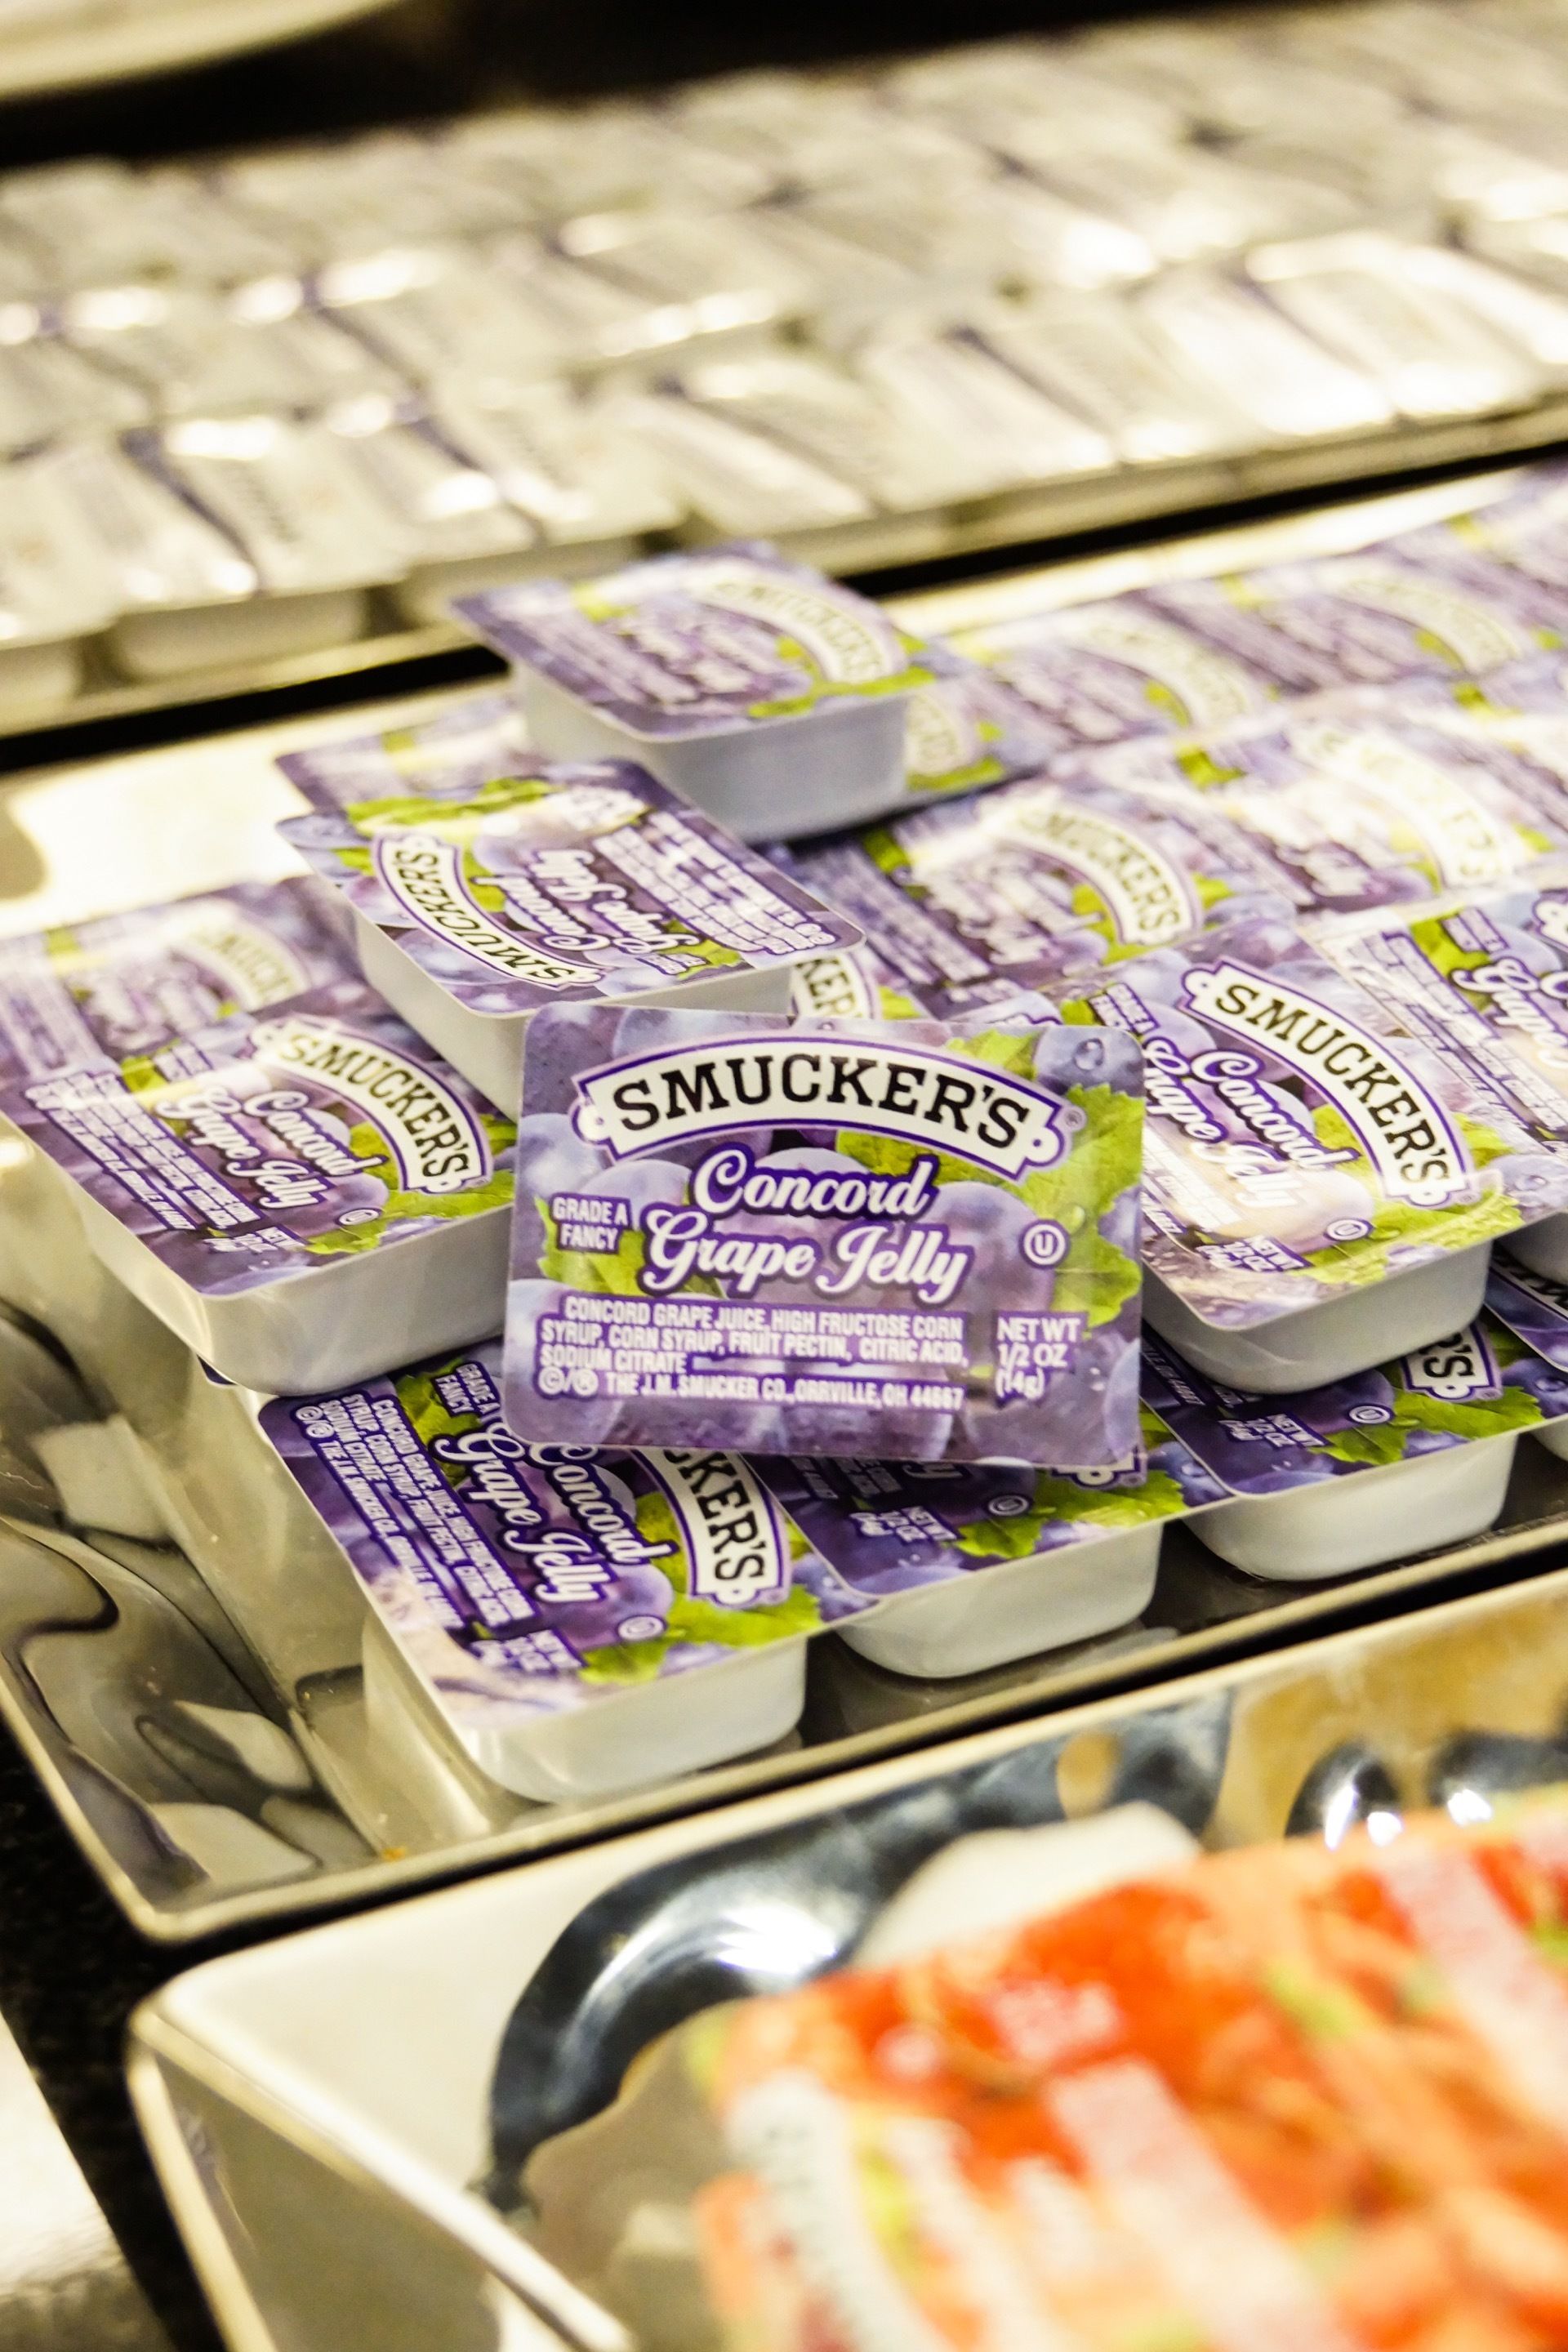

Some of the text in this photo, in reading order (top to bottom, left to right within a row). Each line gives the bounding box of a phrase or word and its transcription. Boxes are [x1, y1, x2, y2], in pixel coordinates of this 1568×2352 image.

[396, 849, 575, 979] SMUCKER'S
[280, 1033, 470, 1177] SMUCKER'S
[612, 1054, 1030, 1149] SMUCKER'S
[1191, 1051, 1357, 1169] Concord
[1216, 984, 1451, 1184] SMUCKER'S
[156, 1088, 261, 1160] Grape
[227, 1160, 326, 1208] Jelly
[245, 1091, 383, 1176] Concord
[553, 1196, 628, 1226] GRADE A
[694, 1148, 933, 1214] Concord
[560, 1224, 618, 1250] FANCY
[643, 1209, 969, 1303] Grape Jelly
[541, 1319, 969, 1367] SYRUP, CORN SYRUP, FRUIT PECTIN, CITRIC ACID,
[564, 1296, 650, 1325] CONCORD
[653, 1303, 713, 1329] GRAPE
[771, 1309, 816, 1333] HIGH
[818, 1312, 911, 1338] FRUCTOSE
[912, 1315, 964, 1340] CORN
[997, 1316, 1080, 1343] NET WT
[456, 1363, 496, 1404] GRADE
[541, 1344, 688, 1374] SODIUM CITRATE
[606, 1373, 639, 1396] THE
[677, 1374, 759, 1399] SMUCKER
[998, 1343, 1068, 1369] 1/2 OZ
[435, 1374, 474, 1414] FANCY
[434, 1422, 542, 1526] Grape
[503, 1532, 612, 1602] Jelly
[529, 1444, 672, 1564] Concord
[664, 1450, 766, 1579] KER'S
